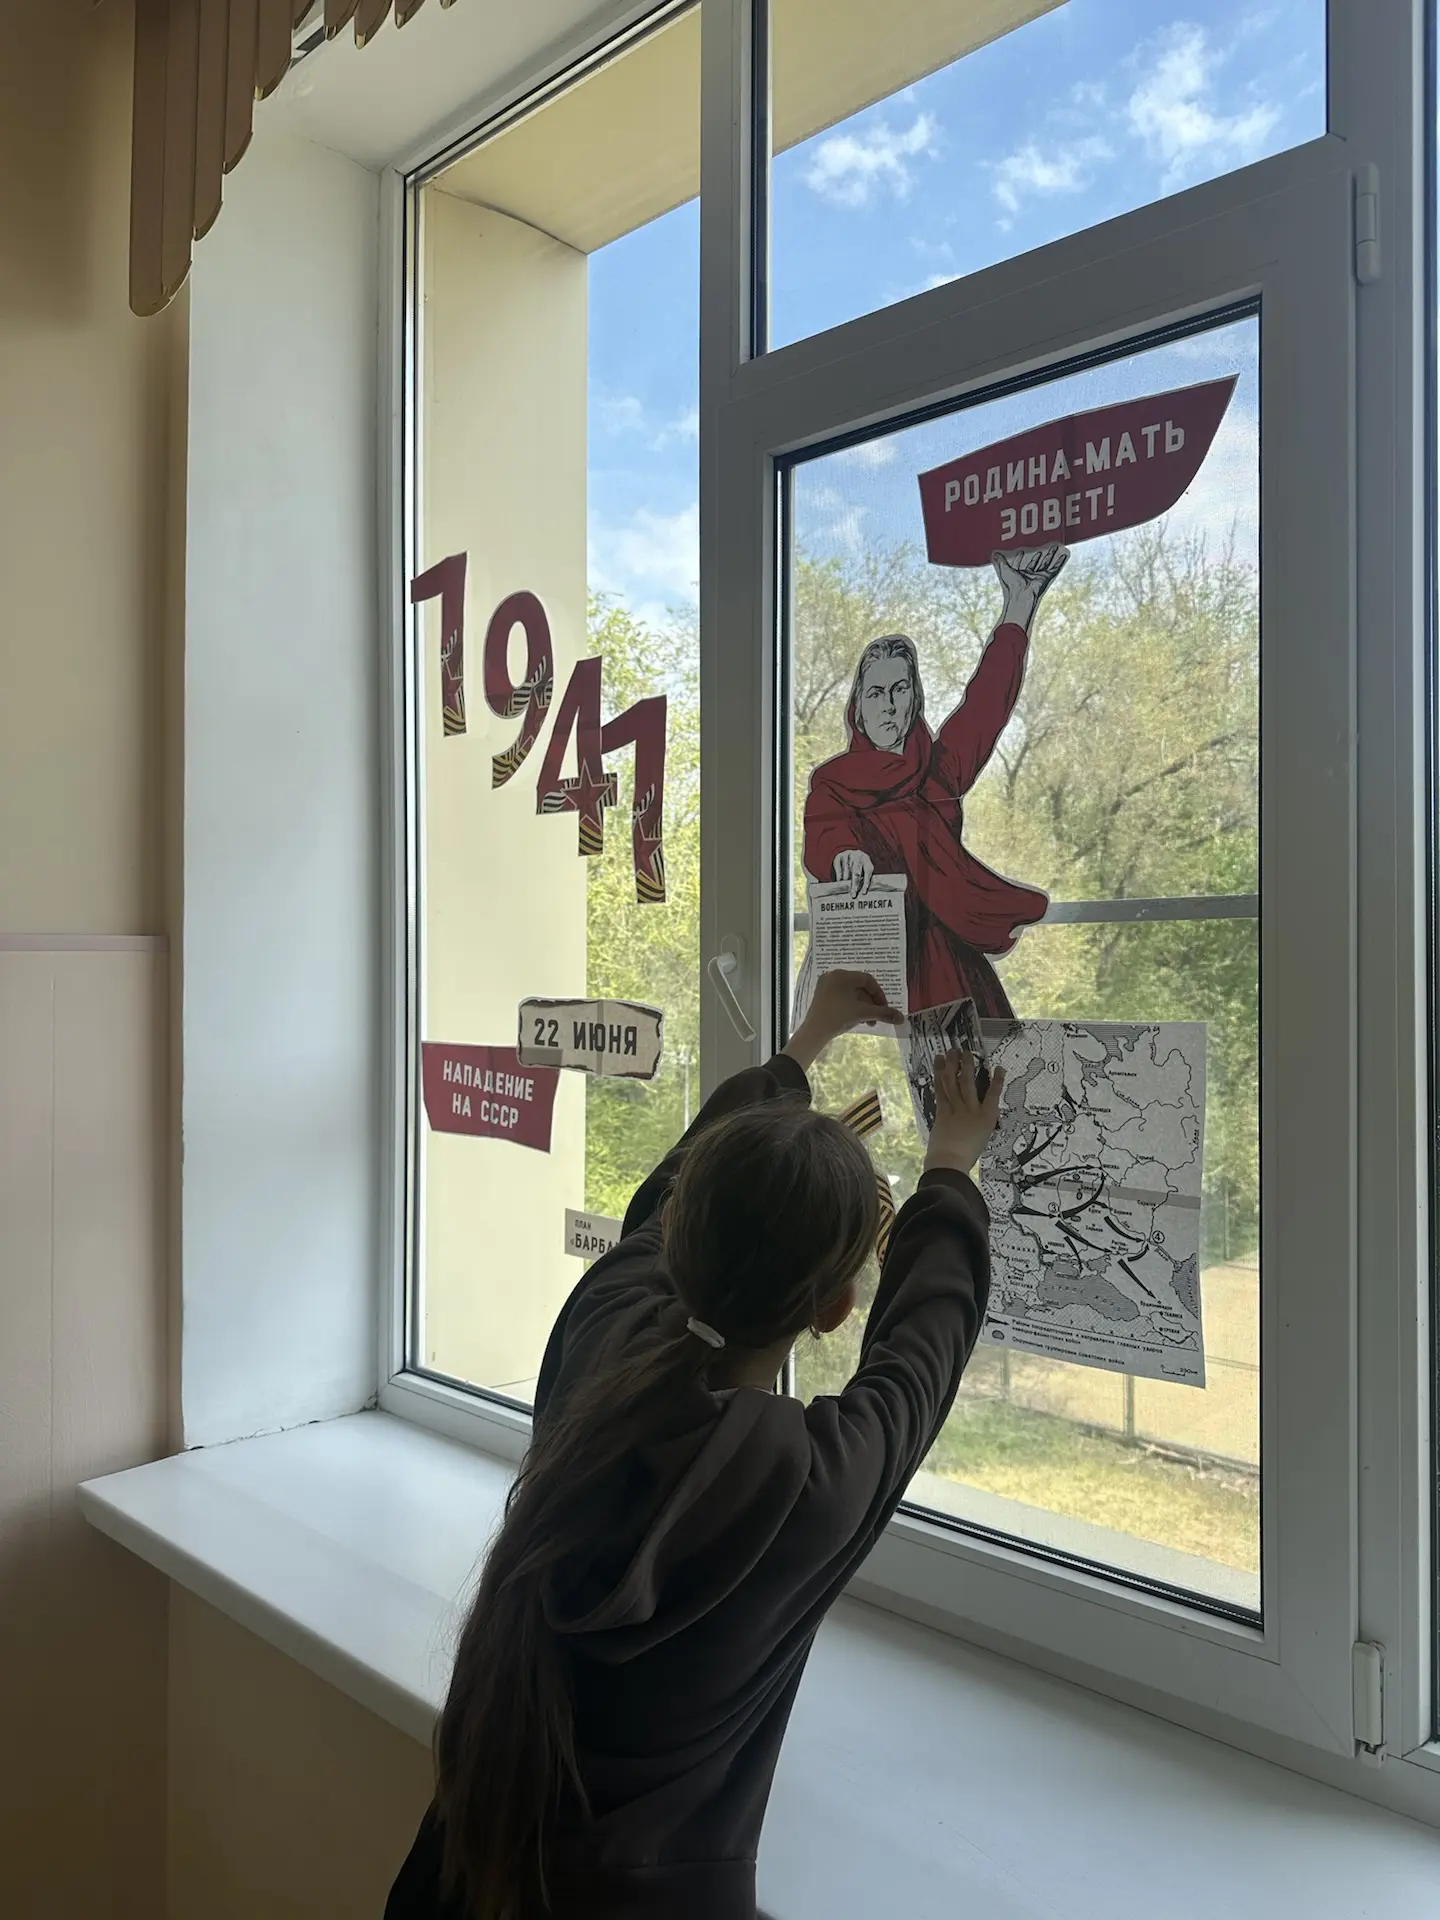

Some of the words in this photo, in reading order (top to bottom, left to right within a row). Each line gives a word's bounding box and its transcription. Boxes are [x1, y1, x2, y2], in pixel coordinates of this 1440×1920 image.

[945, 420, 1185, 512] РОДИНА-МАТЬ
[1000, 484, 1115, 541] ЗОВЕТ!
[411, 550, 667, 904] 1941
[820, 901, 855, 912] ВОЕННАЯ
[858, 899, 893, 910] ПРИСЯГА
[534, 1018, 559, 1047] 22
[573, 1021, 637, 1056] ИЮНЯ
[443, 1060, 534, 1102] НАПАДЕНИЕ
[452, 1093, 471, 1118] НА
[480, 1104, 519, 1129] СССР
[569, 1233, 619, 1254] «БАРБА
[575, 1219, 592, 1231] ПЛАН
